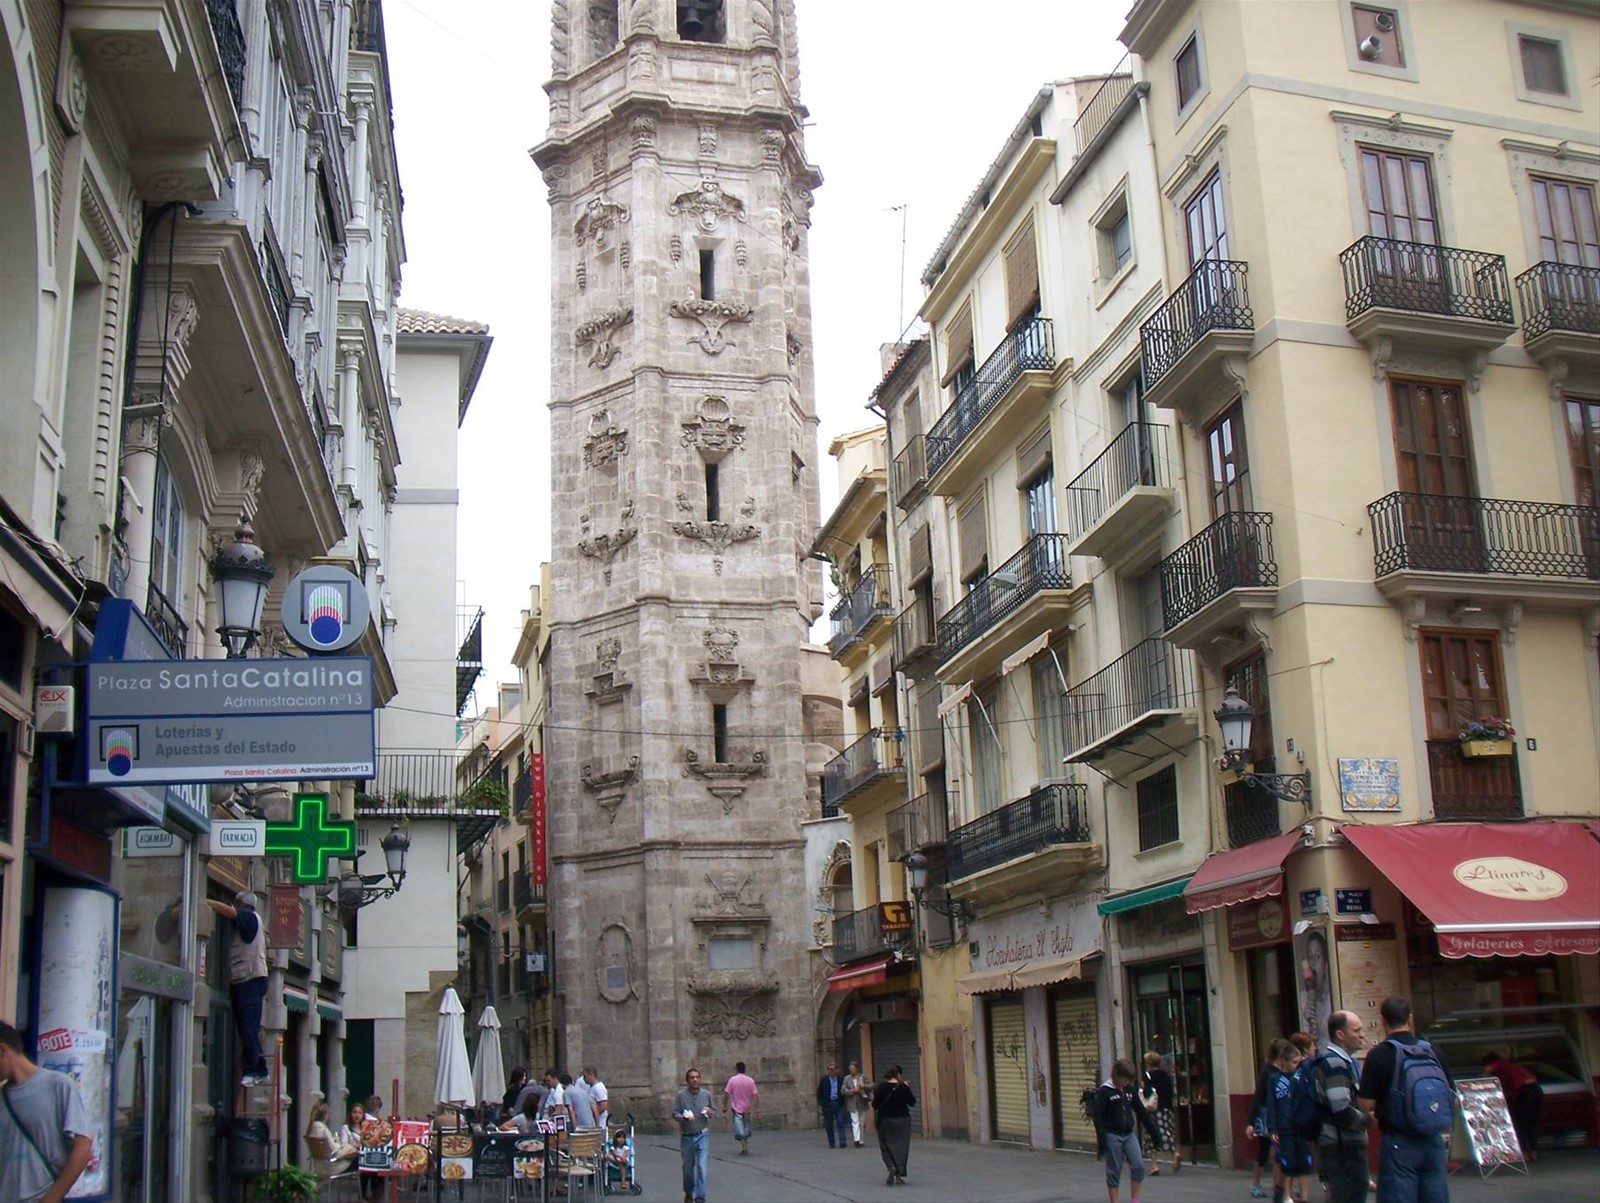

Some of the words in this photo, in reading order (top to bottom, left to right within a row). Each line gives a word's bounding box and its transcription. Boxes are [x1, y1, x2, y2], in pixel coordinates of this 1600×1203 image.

[98, 676, 151, 690] Plaza
[215, 728, 224, 741] y
[155, 743, 220, 758] Apuestas
[224, 742, 245, 754] del
[249, 740, 296, 754] Estado
[224, 768, 243, 776] Plaza
[245, 767, 265, 776] Santa
[267, 766, 297, 775] Catalina
[300, 764, 350, 773] Administración
[223, 832, 253, 842] FARMACIA
[1447, 936, 1524, 956] Gelateries
[41, 1032, 72, 1052] BOTE
